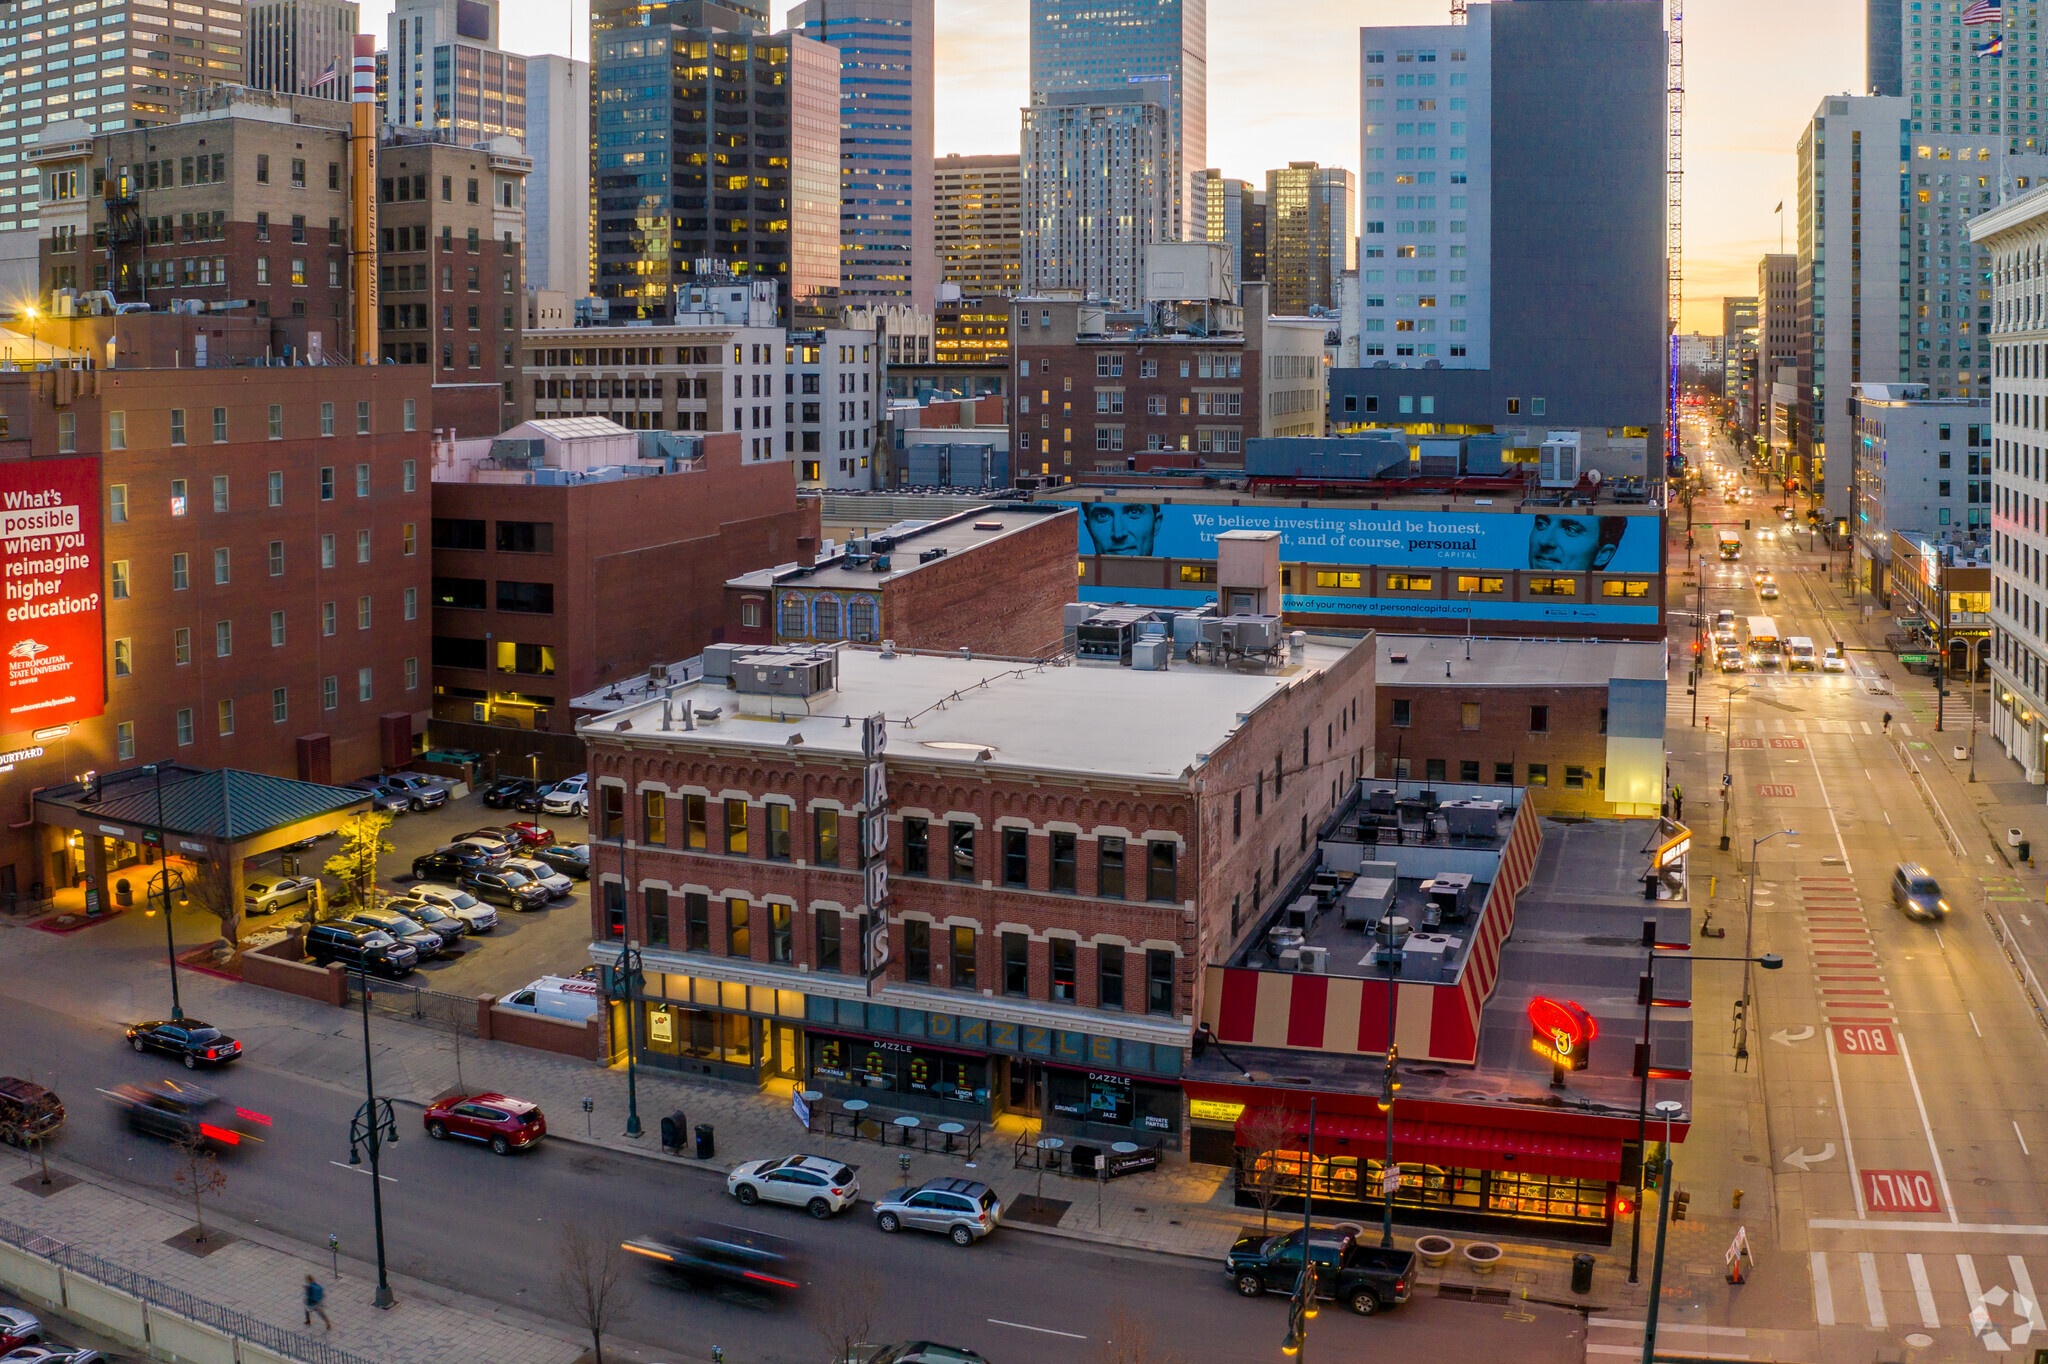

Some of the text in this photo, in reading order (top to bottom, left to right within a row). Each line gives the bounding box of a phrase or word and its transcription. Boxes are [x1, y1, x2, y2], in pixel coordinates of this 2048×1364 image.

[4, 489, 62, 509] What's
[5, 510, 74, 535] possible
[1192, 514, 1486, 535] We believe investing should be honest,
[5, 533, 85, 554] when you
[1298, 534, 1326, 546] and
[1330, 535, 1346, 547] of
[1349, 537, 1405, 549] course,
[1408, 538, 1477, 552] personal
[1437, 551, 1477, 559] CAPITAL
[6, 553, 90, 577] reimagine
[6, 579, 62, 601] higher
[7, 593, 99, 622] education?
[1316, 602, 1336, 610] your
[1337, 603, 1367, 611] money
[1369, 603, 1379, 611] at
[1380, 604, 1471, 614] personalcapital.com
[9, 655, 66, 671] METROPOLITAN
[9, 669, 30, 680] STATE
[18, 677, 38, 686] DENVER
[1735, 739, 1758, 747] BUS
[1775, 739, 1799, 748] BUS
[1761, 785, 1793, 796] ONLY
[932, 1015, 1112, 1059] DAZZLE
[1843, 1028, 1887, 1051] BUS
[874, 1041, 912, 1053] DAZZLE
[817, 1067, 844, 1077] COCKTAILS
[864, 1074, 883, 1083] DINNER
[1089, 1072, 1131, 1086] DAZZLE
[911, 1082, 927, 1090] VINYL
[955, 1089, 973, 1097] LUNCH
[1145, 1116, 1168, 1124] PRIVATE
[1145, 1121, 1169, 1129] PARTIES
[1871, 1174, 1933, 1207] ONLY
